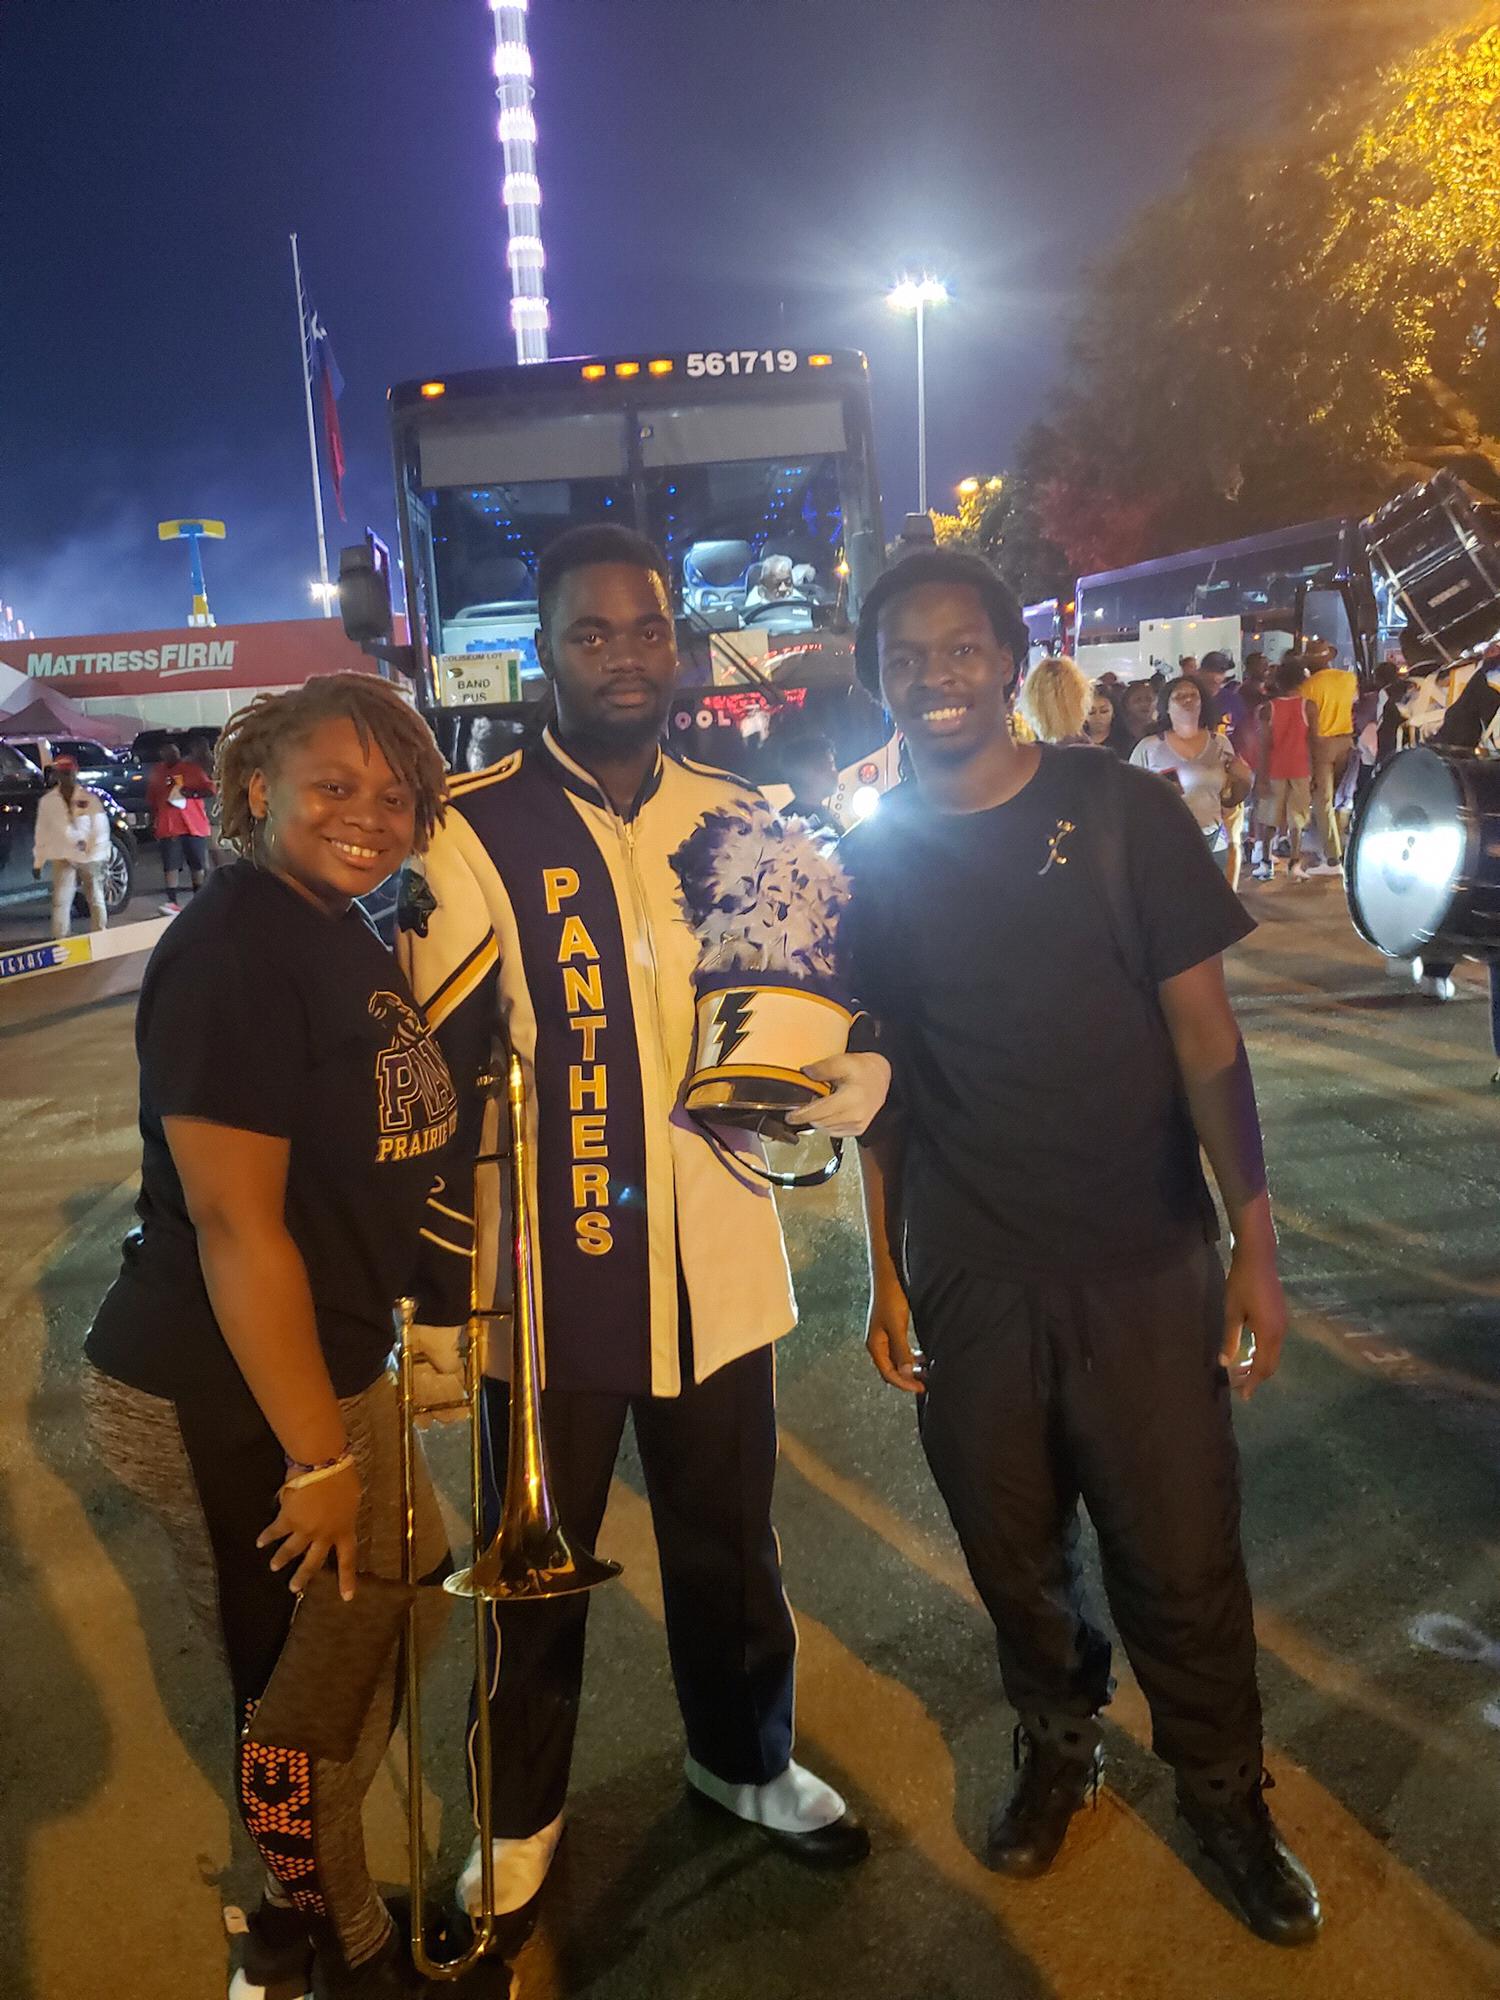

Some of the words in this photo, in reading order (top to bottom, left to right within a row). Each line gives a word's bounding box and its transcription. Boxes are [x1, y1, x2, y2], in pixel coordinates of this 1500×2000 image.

[686, 350, 798, 377] 561719
[457, 679, 491, 690] BAND
[0, 952, 46, 975] TEXAS
[542, 866, 614, 1257] PANTHERS
[375, 1125, 448, 1162] PRAIRIE
